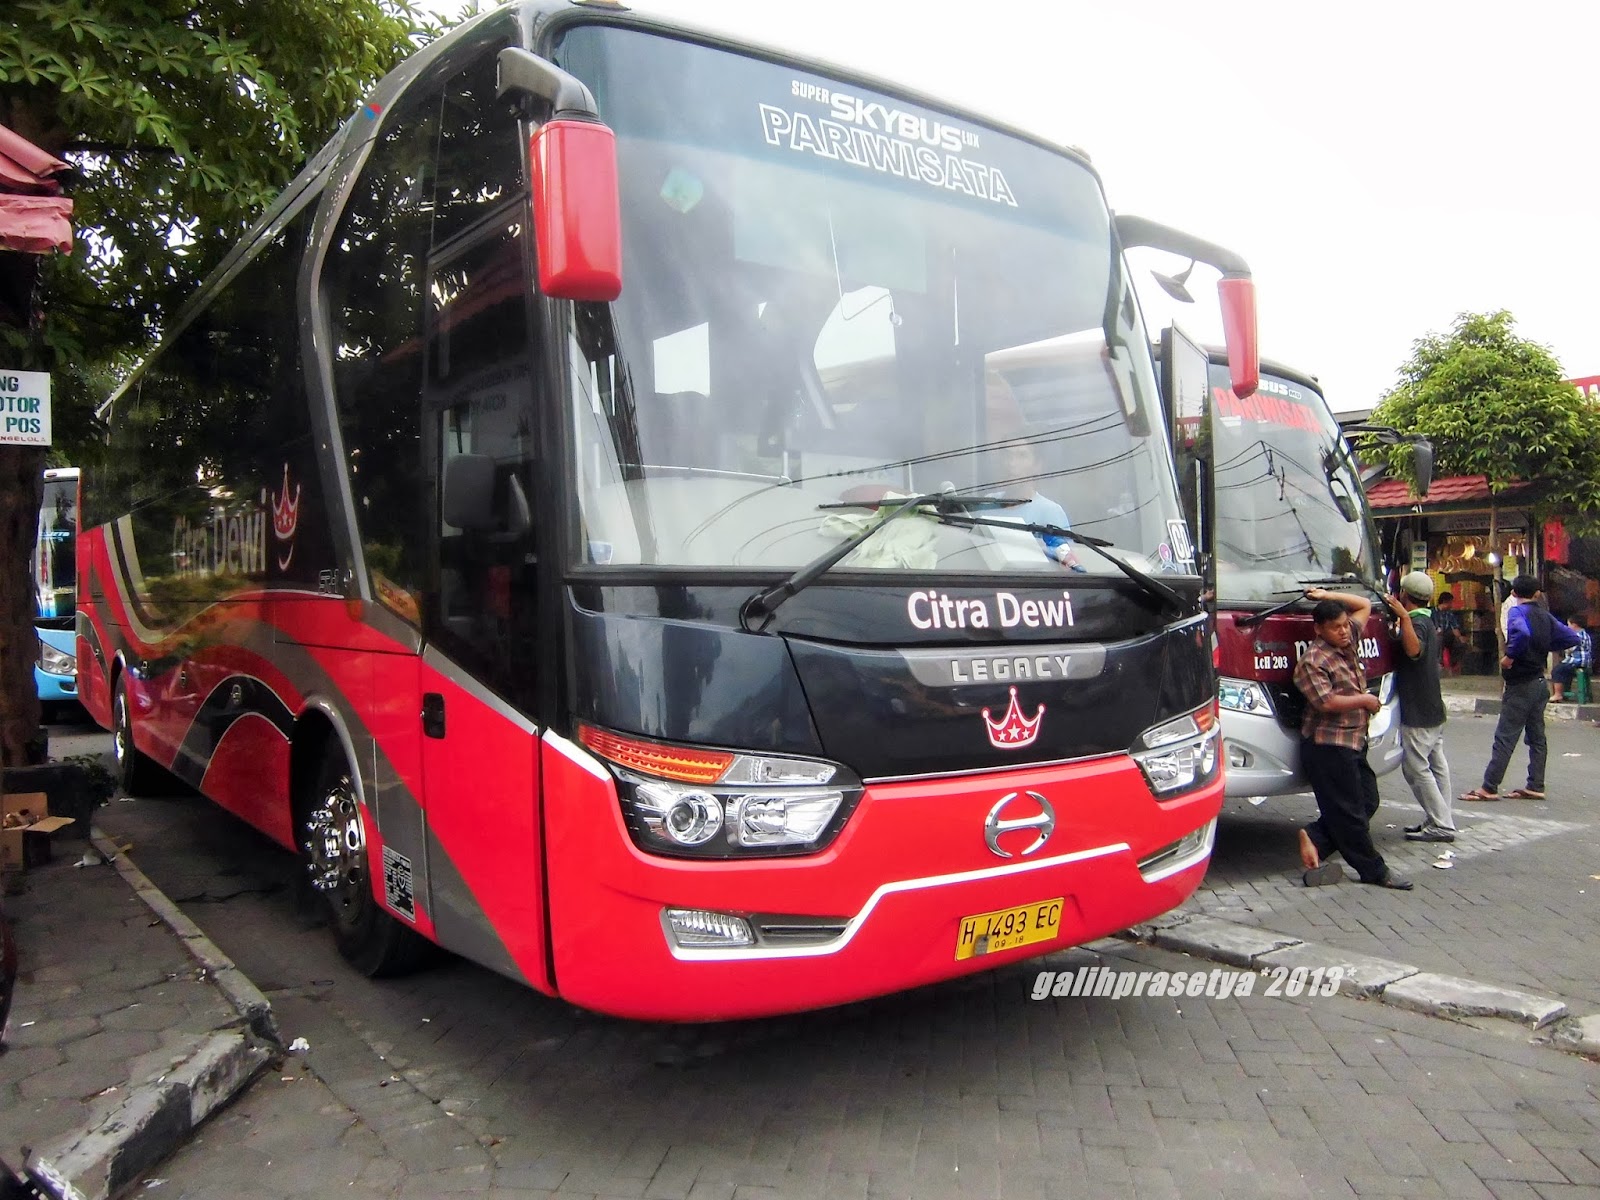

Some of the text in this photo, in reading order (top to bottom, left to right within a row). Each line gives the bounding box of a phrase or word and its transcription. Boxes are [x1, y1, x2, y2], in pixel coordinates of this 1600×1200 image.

[792, 79, 980, 152] SUPER SKYBUS LUX
[758, 102, 1019, 207] PARIWISATA
[6, 417, 41, 434] POS
[213, 487, 267, 576] Dewi
[907, 590, 1075, 629] Citra Dewi
[951, 655, 1072, 682] LEGACY
[962, 904, 1059, 945] H 1493 EC
